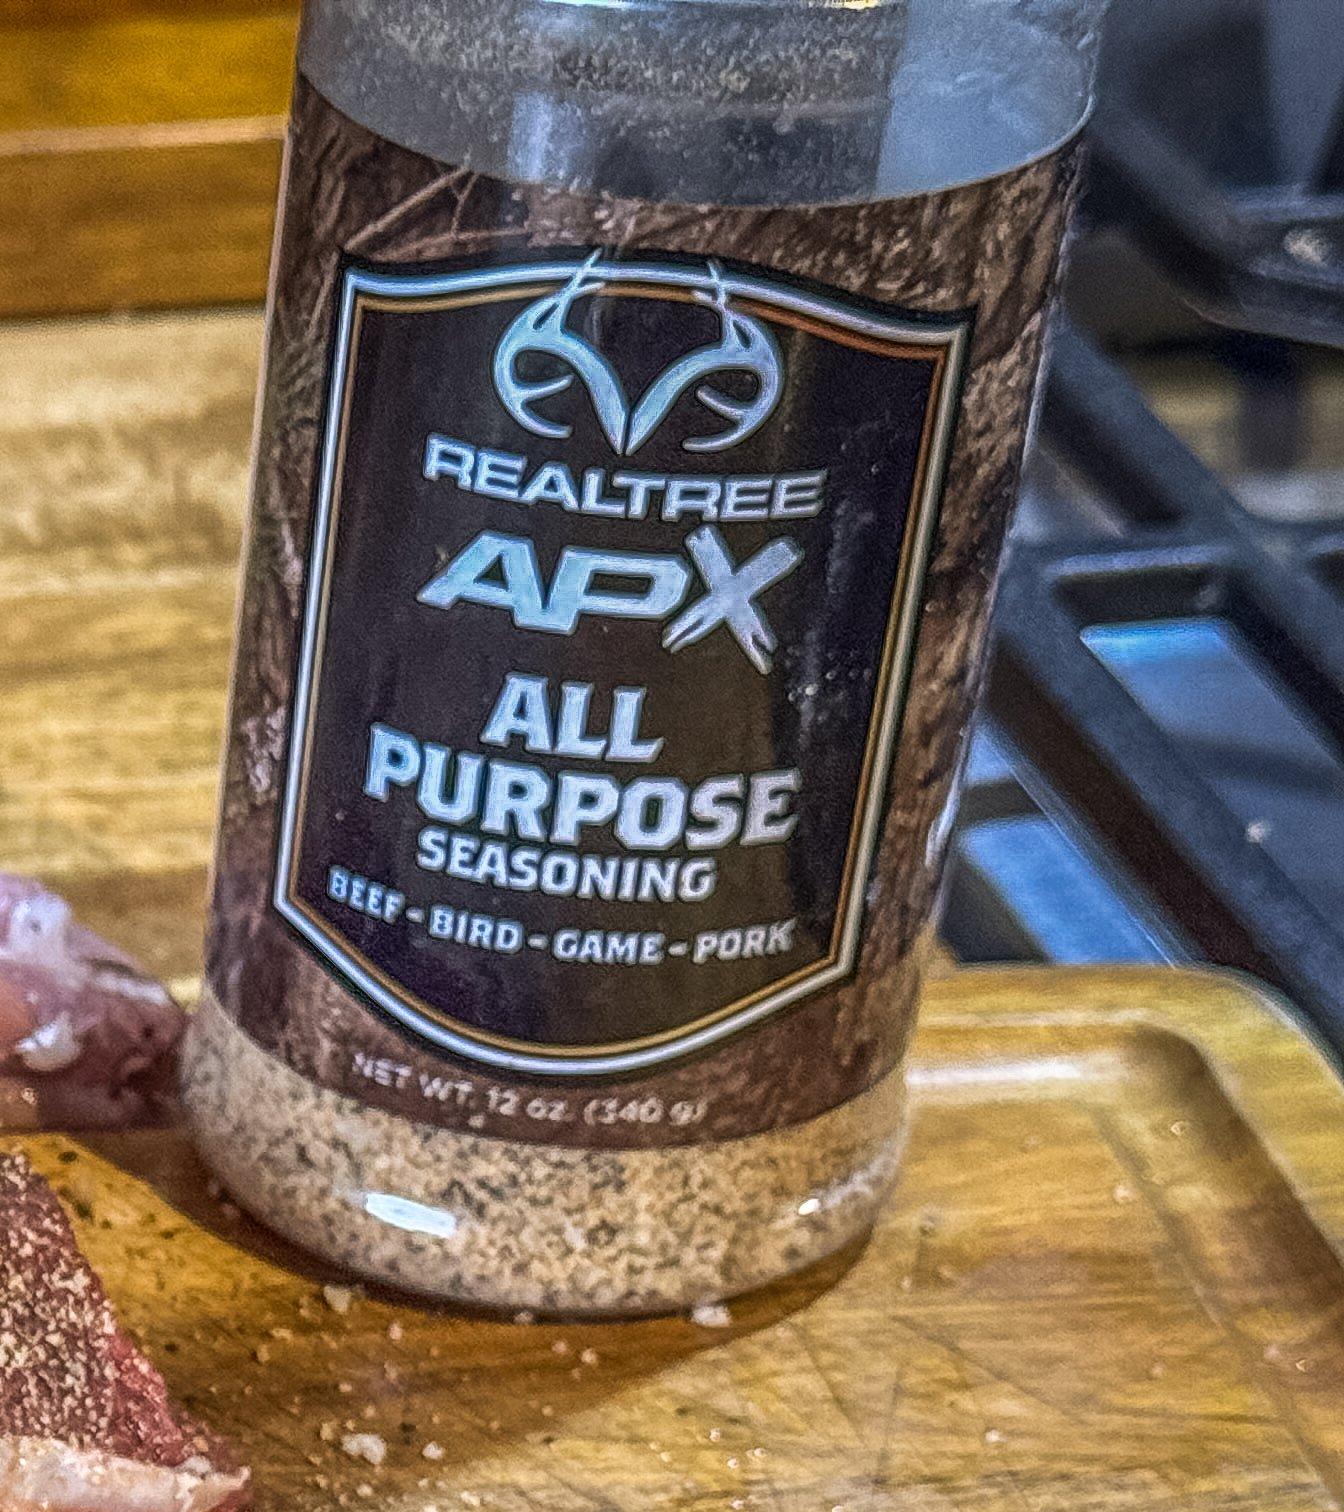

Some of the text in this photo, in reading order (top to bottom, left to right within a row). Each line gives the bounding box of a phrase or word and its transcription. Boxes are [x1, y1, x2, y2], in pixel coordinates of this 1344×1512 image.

[421, 433, 828, 522] REALTREE
[416, 525, 806, 676] APX
[480, 672, 665, 764] ALL
[362, 722, 803, 852] PURPOSE
[416, 828, 717, 903] SEASONING
[327, 866, 404, 923] BEEF
[428, 905, 523, 954] BIRD
[552, 929, 665, 965] GAME
[692, 919, 799, 965] PORK
[353, 1053, 414, 1085] NET
[486, 1090, 517, 1115] 12
